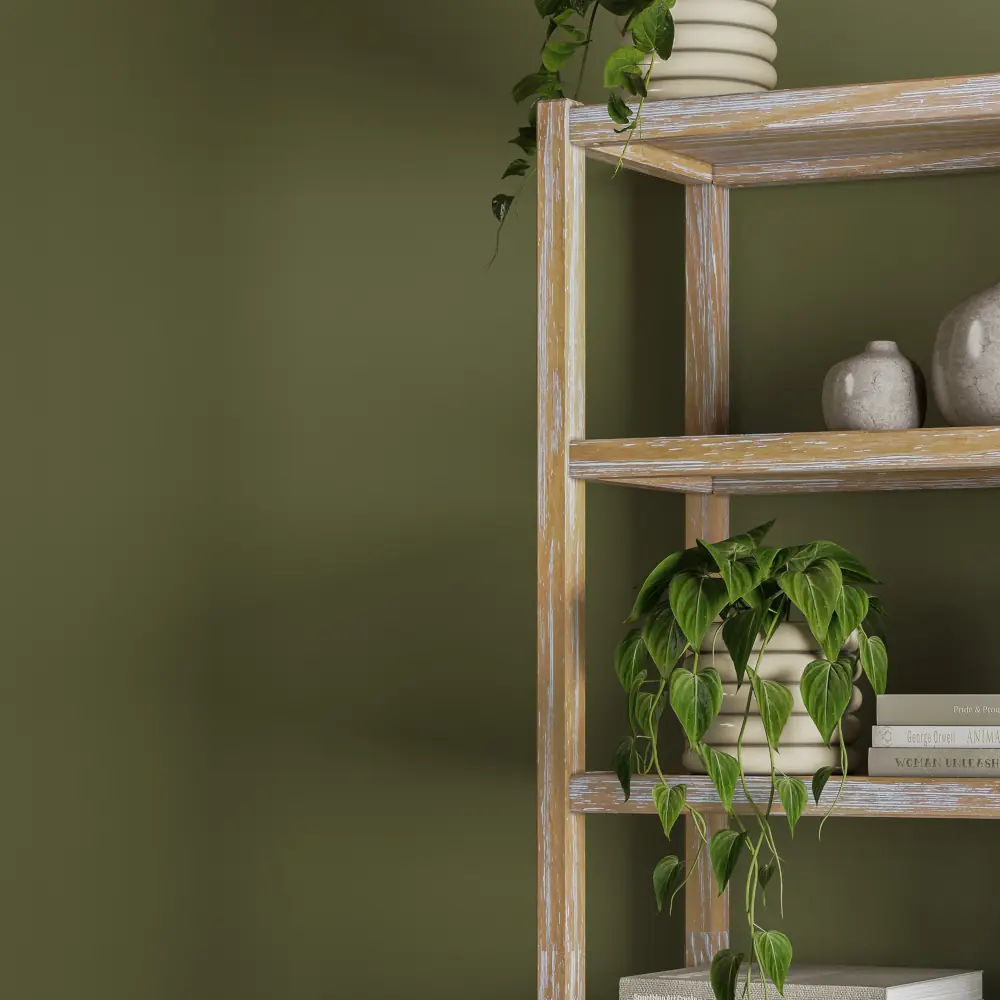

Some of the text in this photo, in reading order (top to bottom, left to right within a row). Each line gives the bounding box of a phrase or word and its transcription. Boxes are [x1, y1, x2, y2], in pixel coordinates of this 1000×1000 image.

[953, 705, 973, 714] Pride
[974, 705, 981, 714] &
[906, 730, 956, 746] George Orwell
[895, 757, 942, 769] WOMAN
